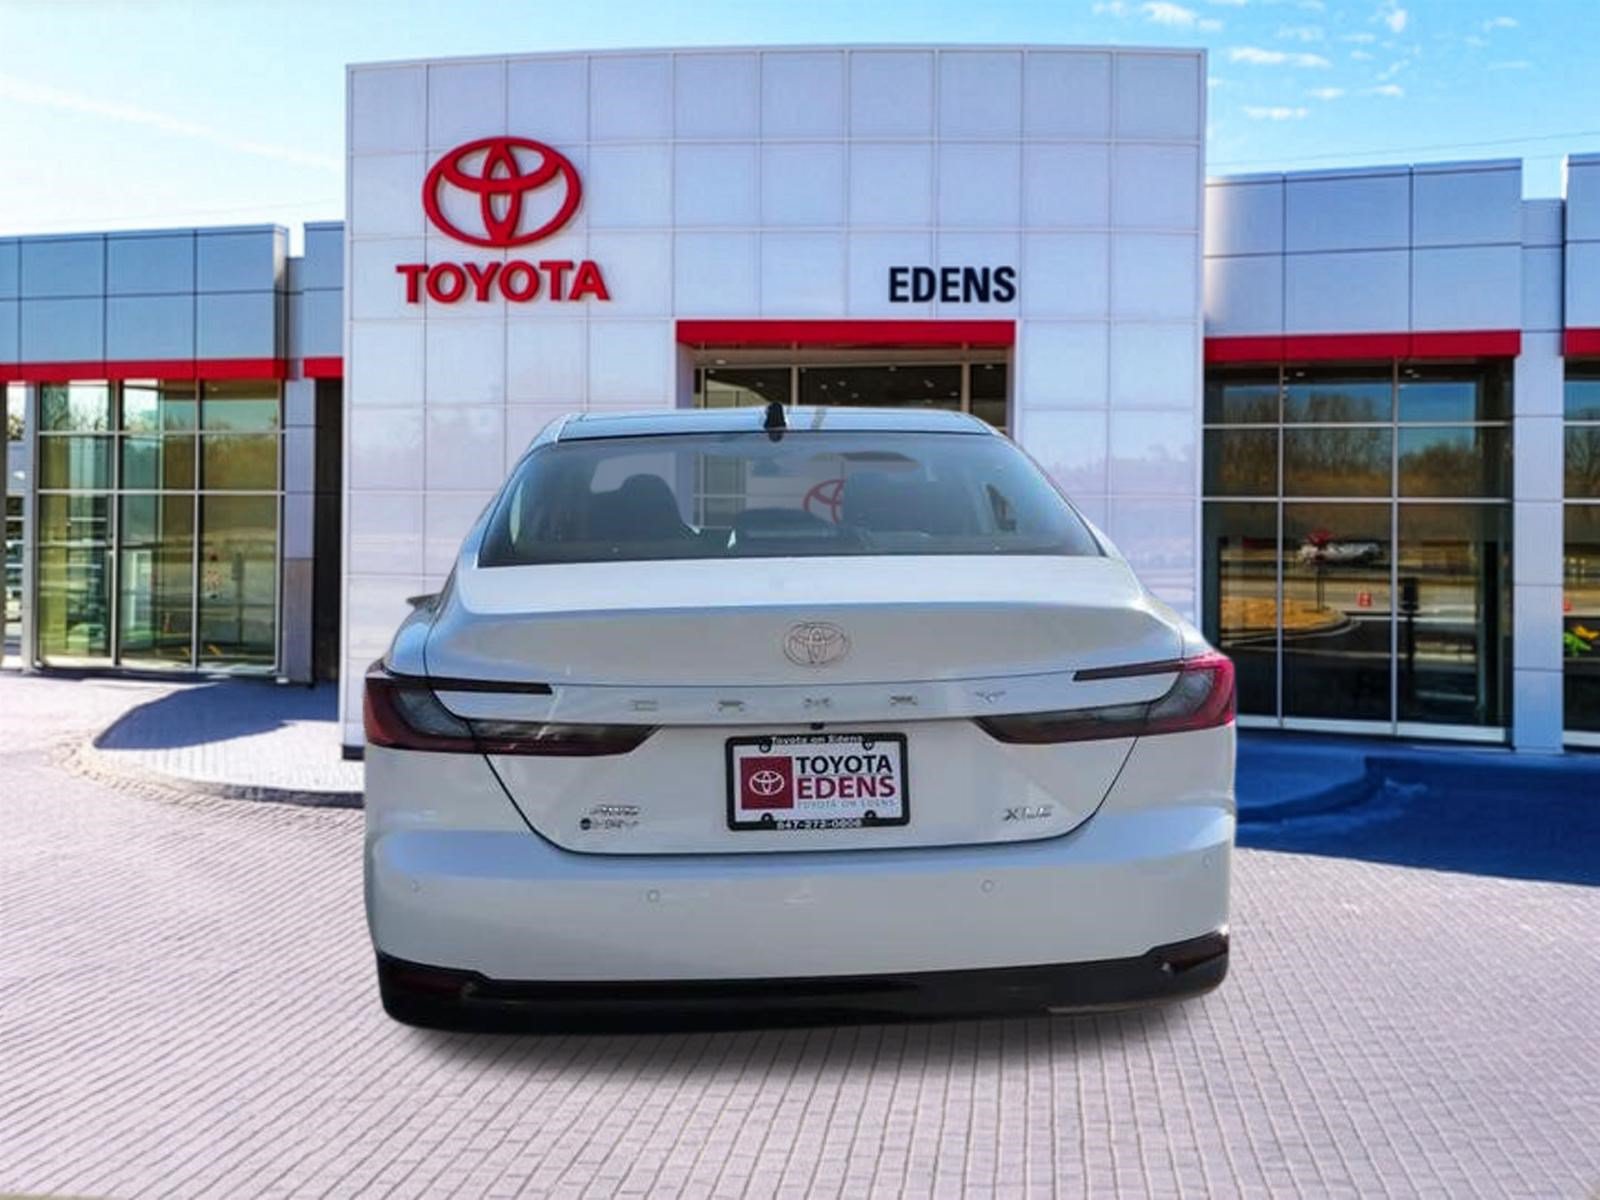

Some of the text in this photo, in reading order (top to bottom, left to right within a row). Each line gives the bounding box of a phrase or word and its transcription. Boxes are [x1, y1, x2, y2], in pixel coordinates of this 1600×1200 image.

[396, 260, 610, 304] TOYOTA
[889, 265, 1017, 303] EDENS
[796, 755, 893, 774] TOYOTA
[797, 775, 895, 799] EDENS
